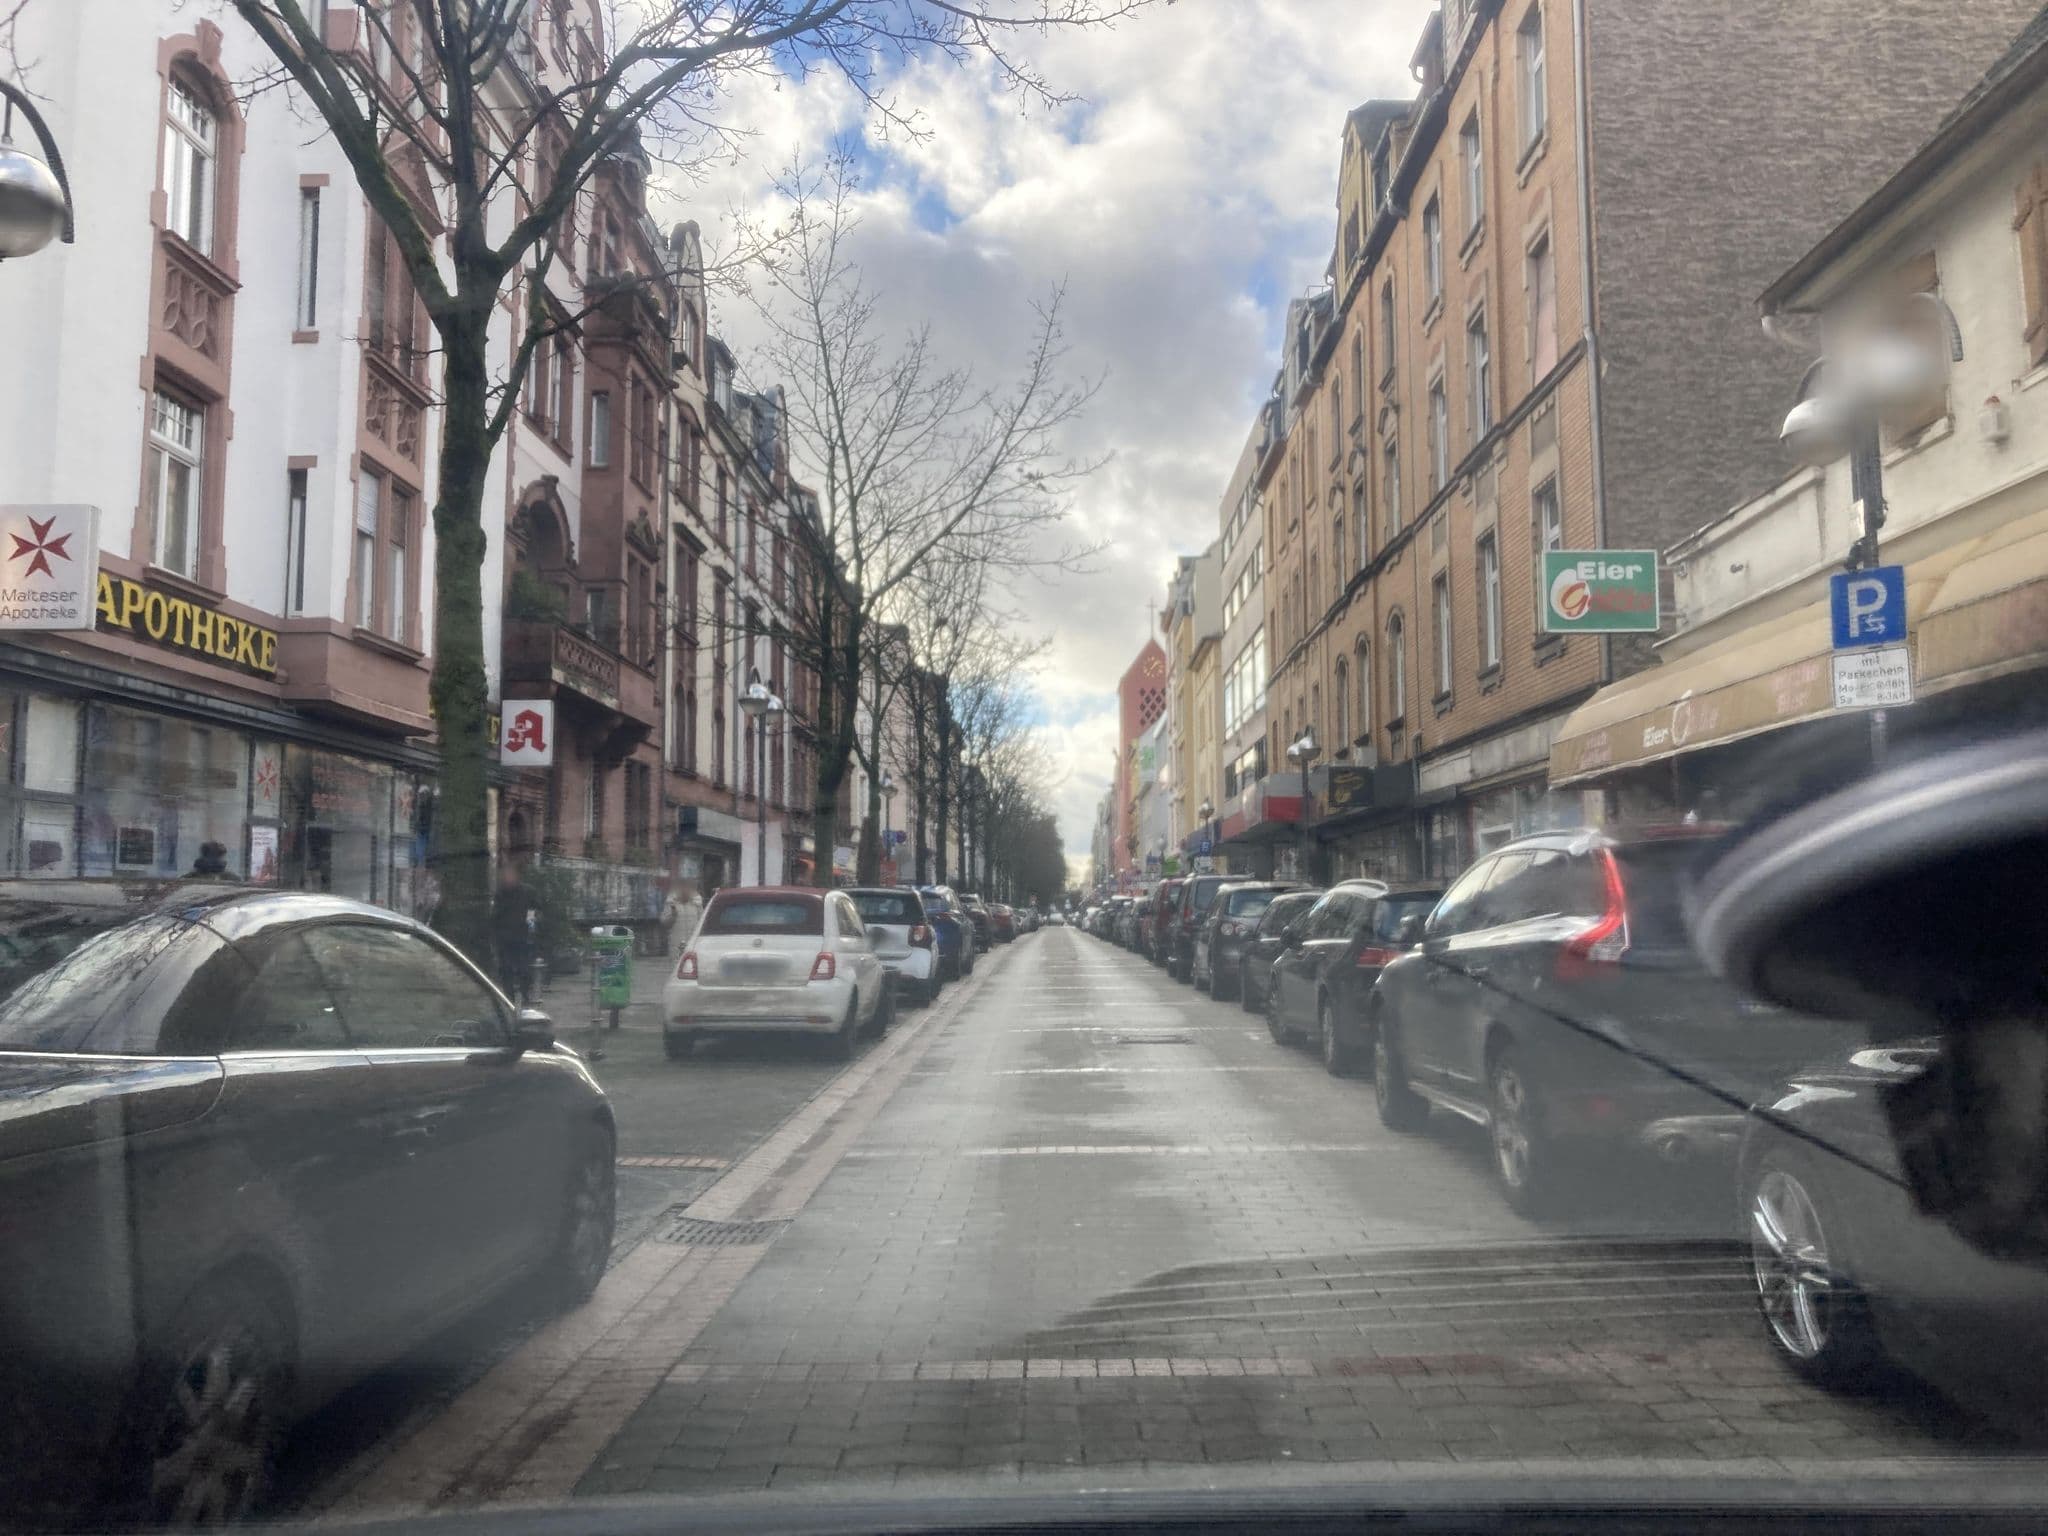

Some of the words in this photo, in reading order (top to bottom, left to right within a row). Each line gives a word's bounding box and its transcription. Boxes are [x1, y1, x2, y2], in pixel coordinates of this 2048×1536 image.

[1577, 561, 1642, 580] Eier
[1, 588, 78, 602] Malteser
[0, 606, 78, 621] Apotheke
[1848, 579, 1888, 638] P
[96, 571, 279, 674] APOTHEKE
[1838, 666, 1905, 681] Parkschein
